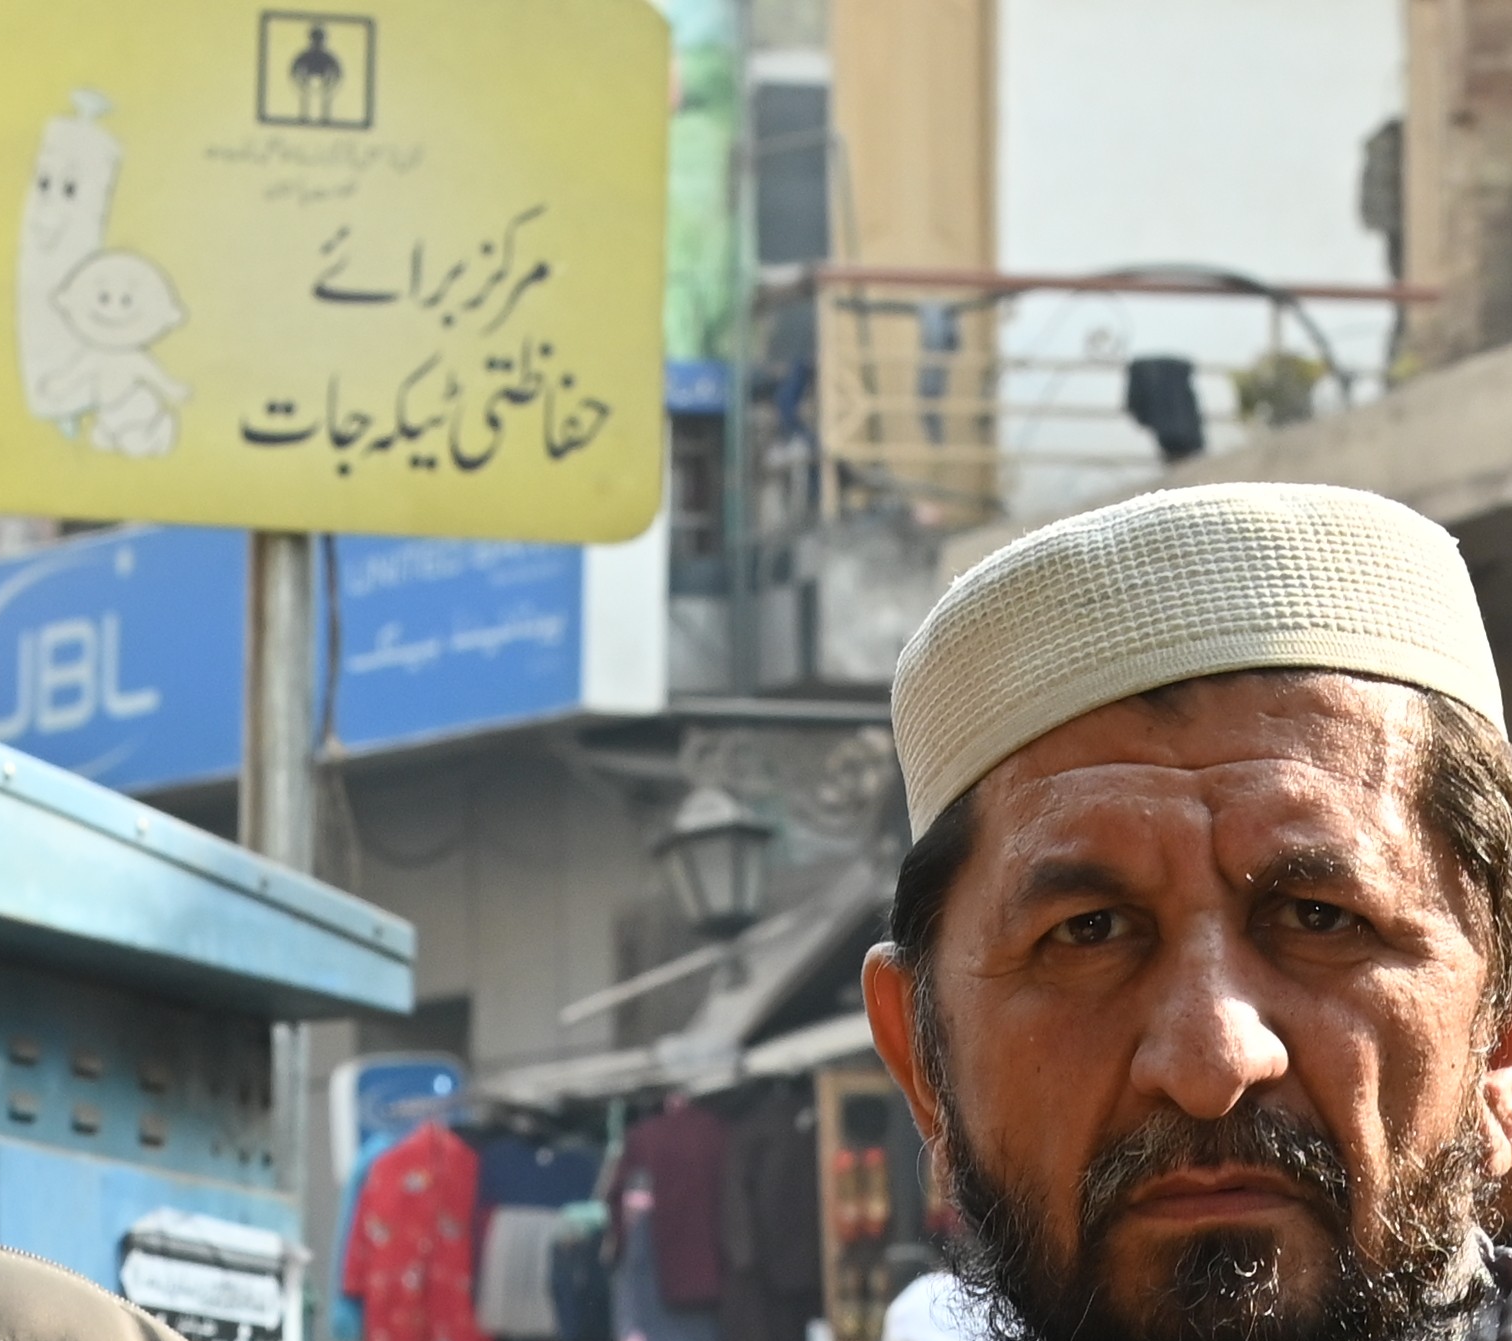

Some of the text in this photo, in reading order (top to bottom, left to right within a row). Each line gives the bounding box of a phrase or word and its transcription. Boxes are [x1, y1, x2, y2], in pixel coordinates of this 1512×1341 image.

[311, 203, 551, 337] مرکز برائے
[239, 334, 613, 478] حفاظتی ٹیکہ جات
